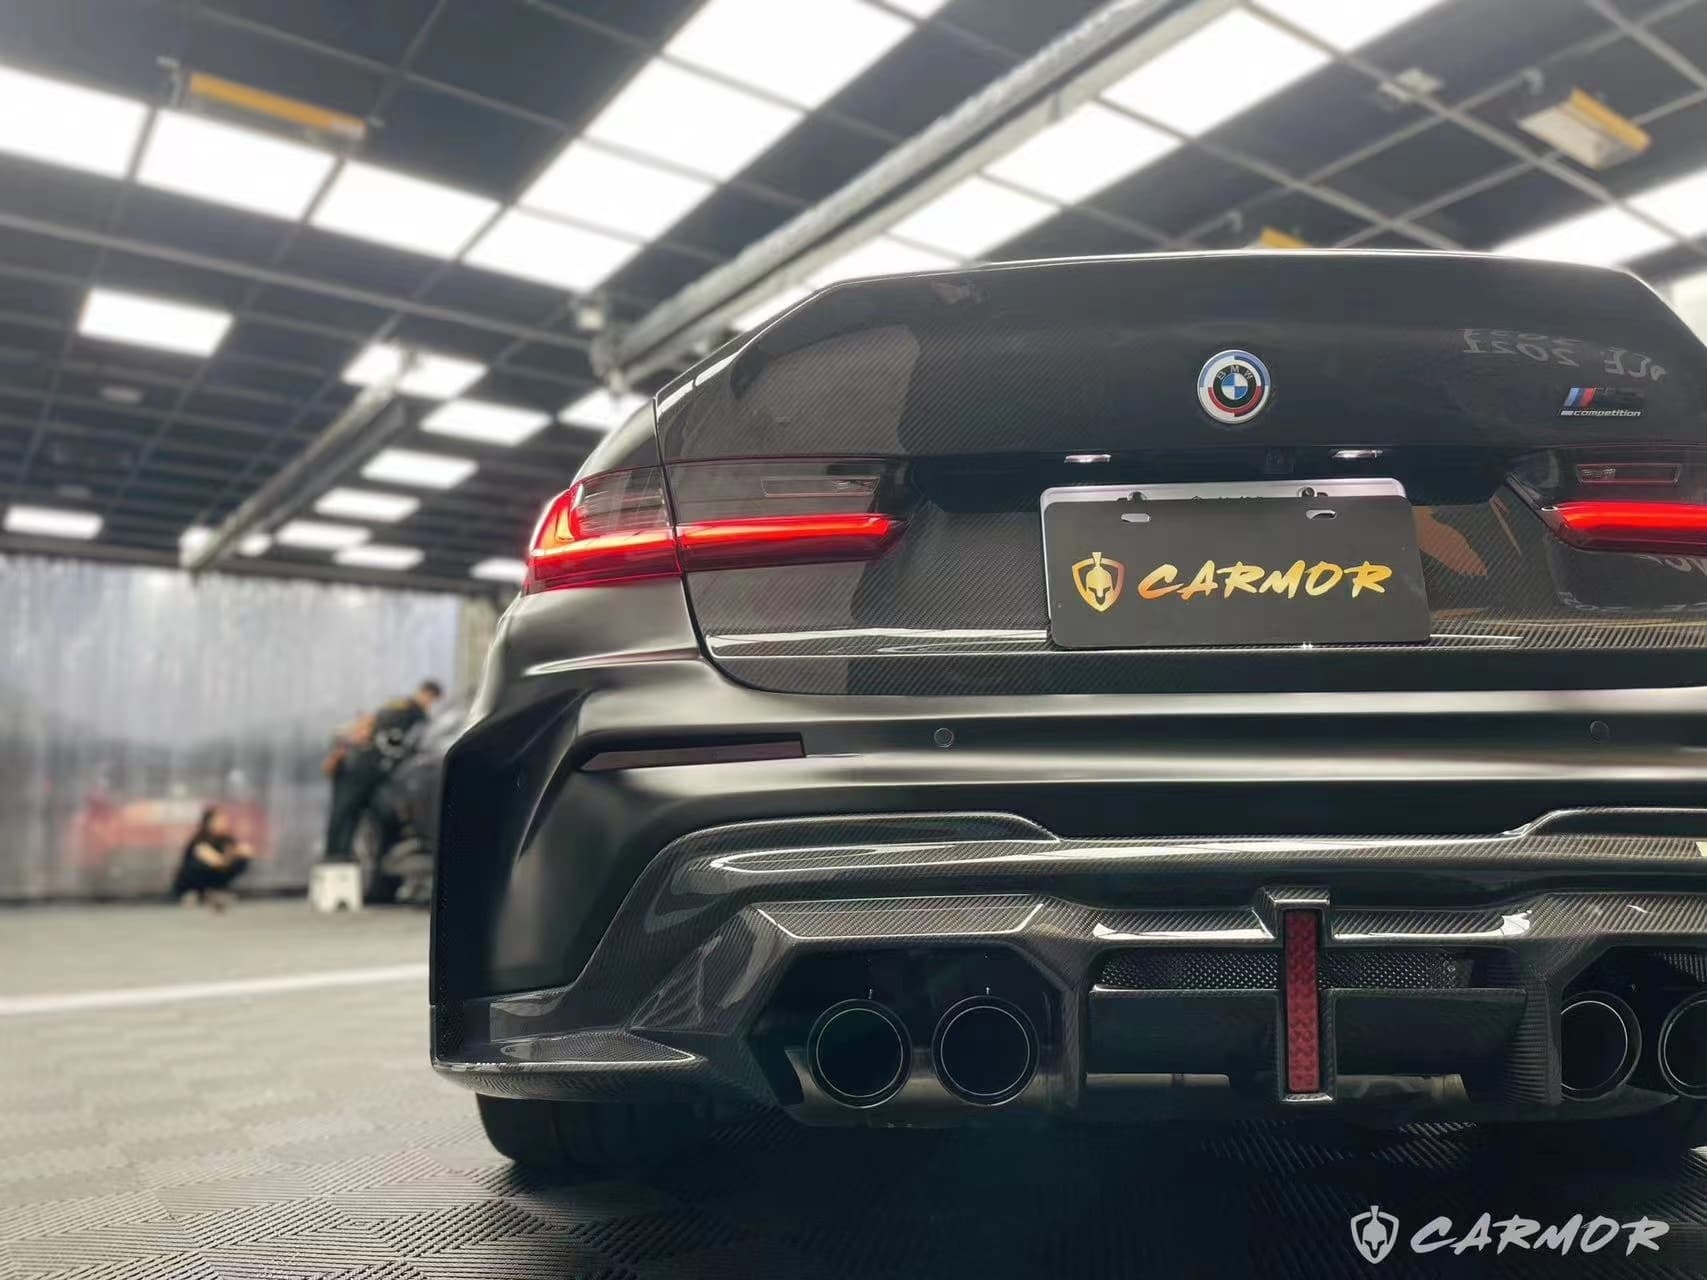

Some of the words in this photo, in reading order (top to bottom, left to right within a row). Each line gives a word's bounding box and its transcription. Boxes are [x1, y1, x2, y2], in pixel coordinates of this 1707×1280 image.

[1217, 365, 1253, 381] BMW
[1574, 409, 1642, 417] competition
[1138, 559, 1393, 600] CARMOR
